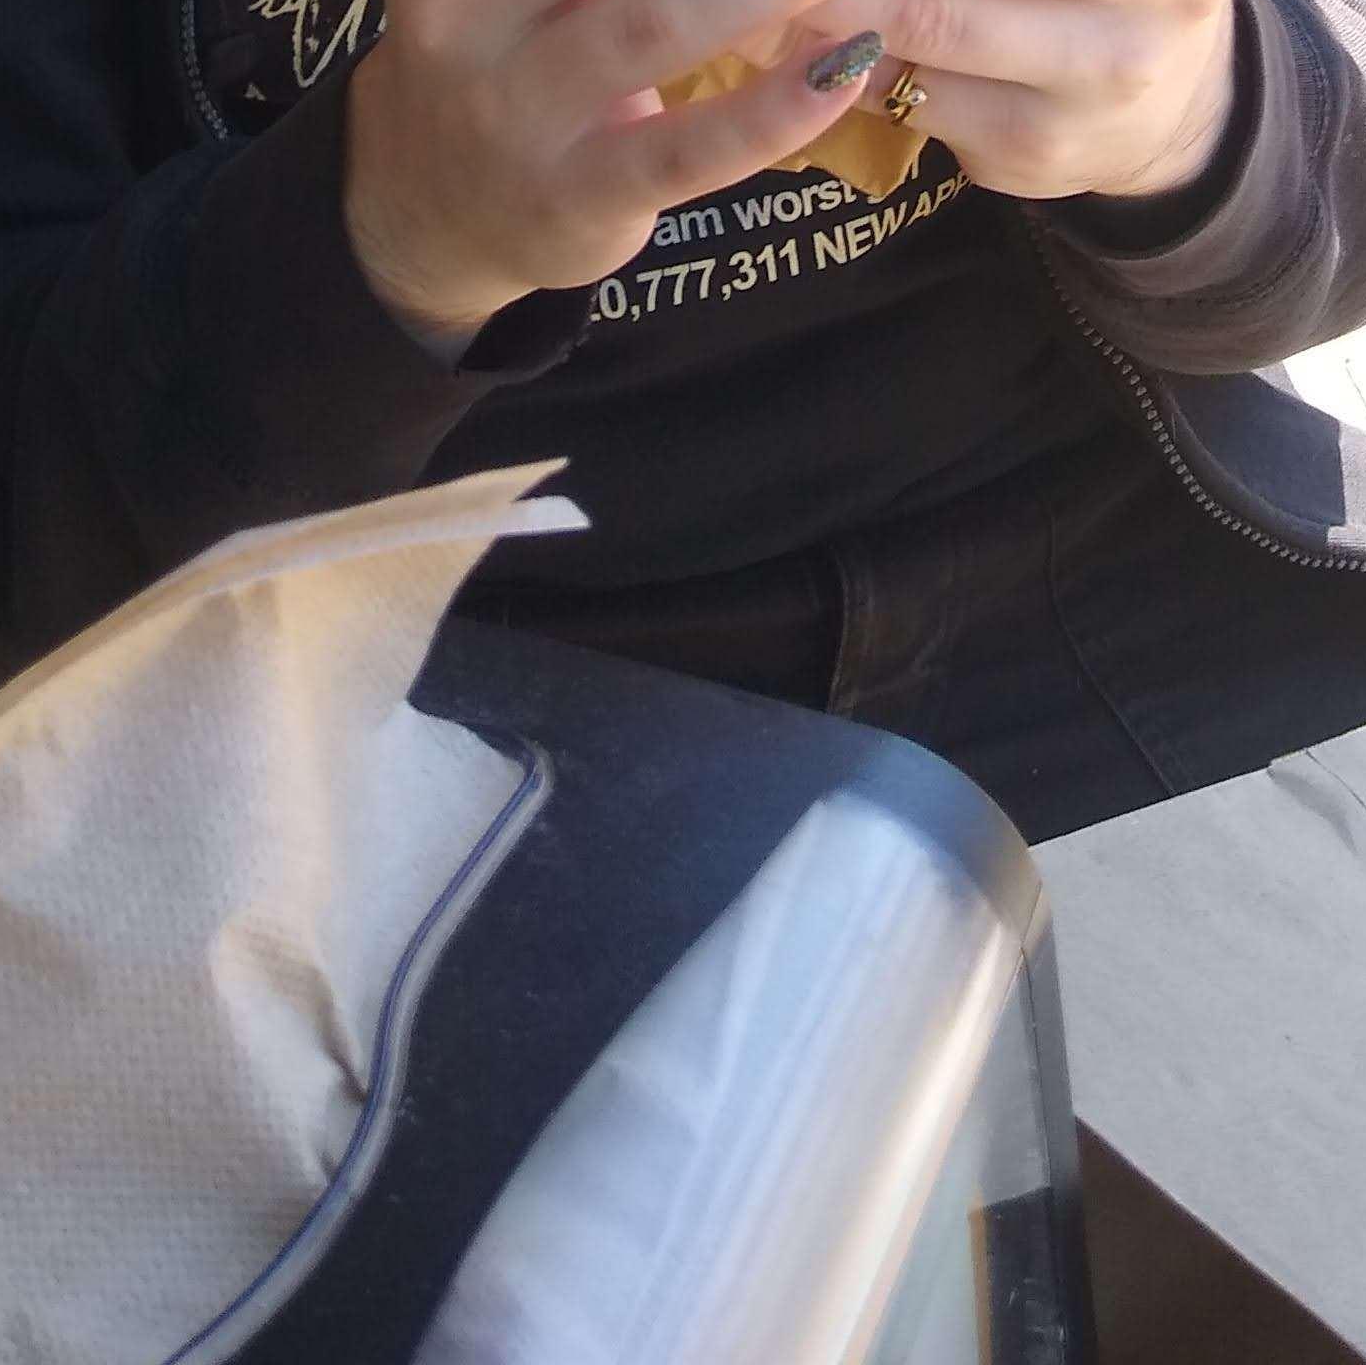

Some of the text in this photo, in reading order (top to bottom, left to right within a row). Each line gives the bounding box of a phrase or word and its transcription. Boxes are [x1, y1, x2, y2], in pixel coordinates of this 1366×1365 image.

[654, 207, 725, 246] am
[731, 179, 857, 231] worst
[590, 238, 800, 321] 0,777,311
[813, 201, 908, 270] NEW
